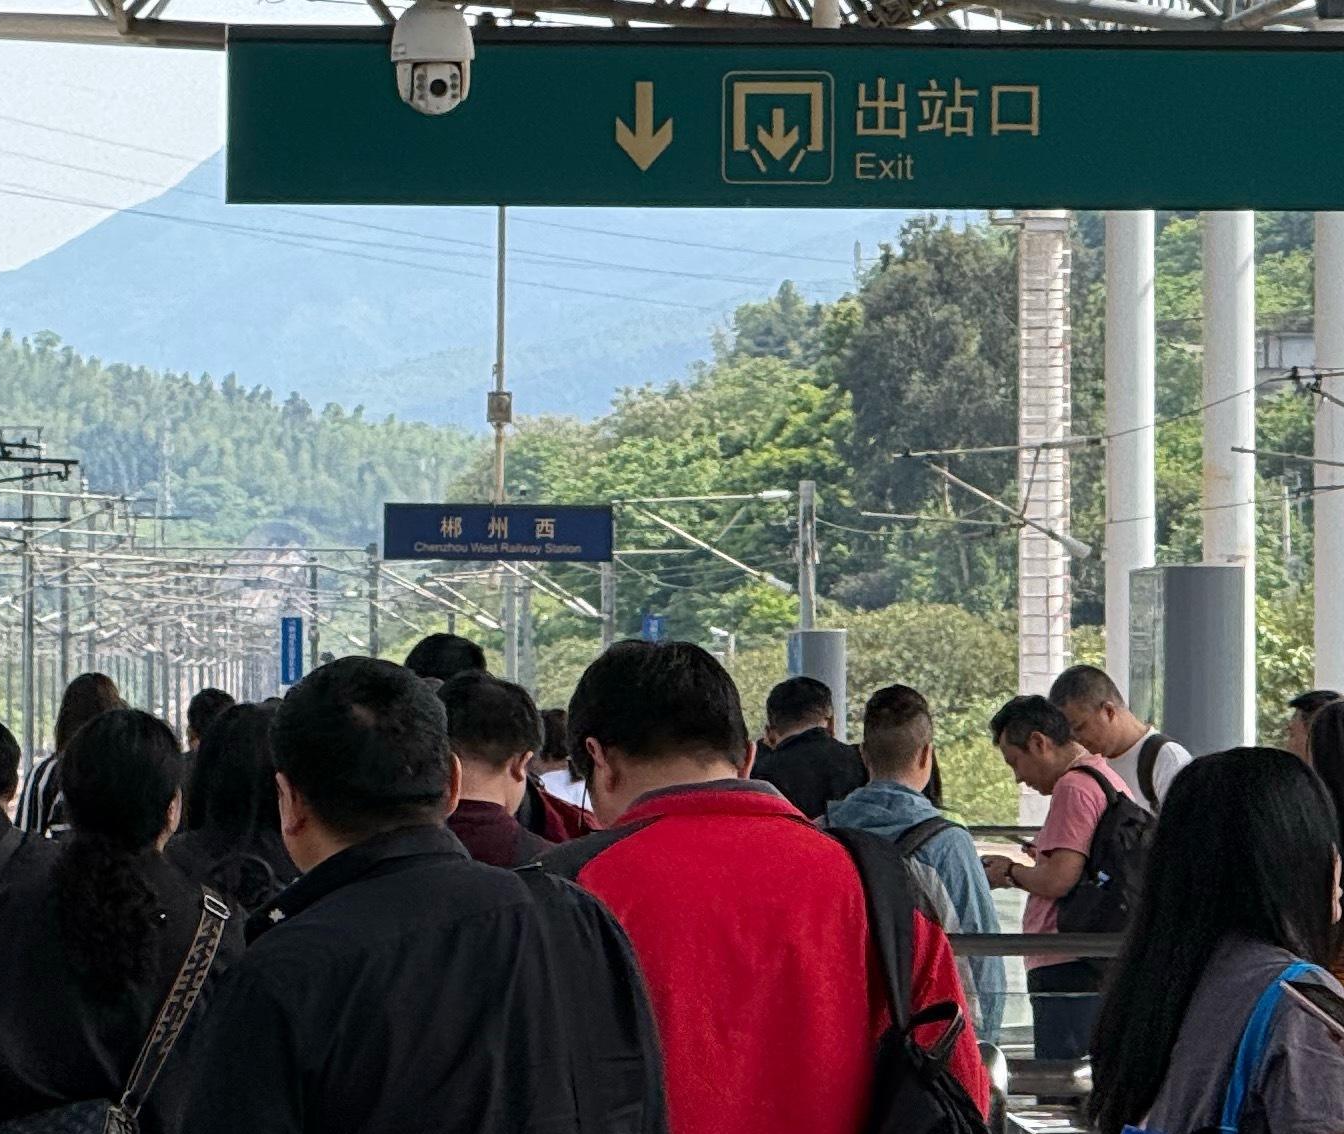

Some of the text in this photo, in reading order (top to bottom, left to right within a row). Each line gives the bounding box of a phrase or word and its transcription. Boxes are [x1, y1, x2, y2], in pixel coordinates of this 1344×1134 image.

[856, 77, 1040, 138] 出站口
[855, 152, 914, 180] Exit
[440, 515, 556, 539] 郴州西
[470, 542, 498, 553] West
[544, 542, 582, 554] Station
